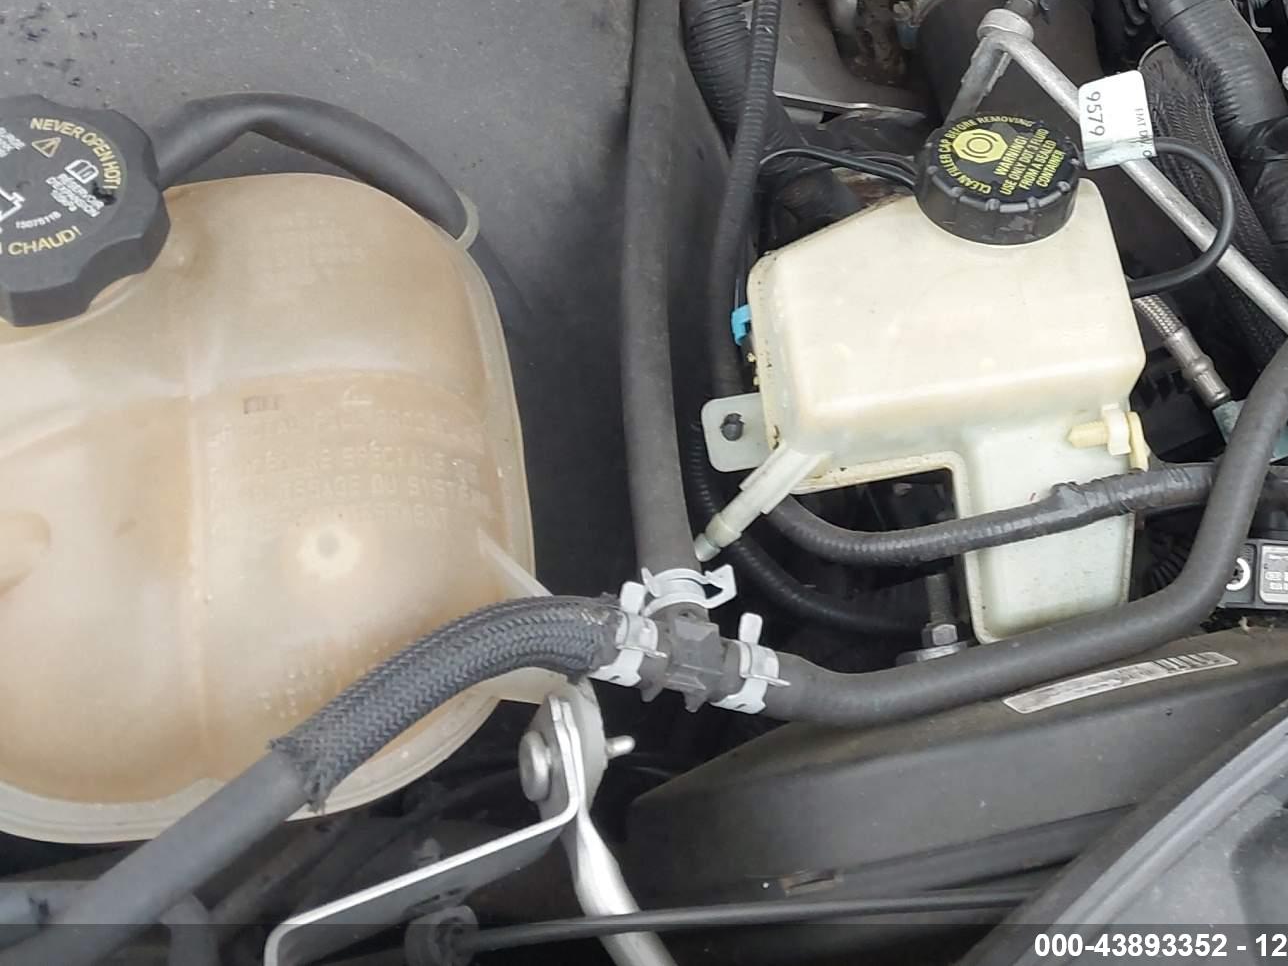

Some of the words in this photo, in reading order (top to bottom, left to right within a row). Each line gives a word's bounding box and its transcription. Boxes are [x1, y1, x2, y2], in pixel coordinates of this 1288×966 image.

[976, 115, 1035, 128] REMOVING
[1086, 91, 1105, 136] 9579
[943, 119, 978, 139] BEFORE
[1031, 128, 1049, 145] FLUID
[30, 117, 85, 139] NEVER
[81, 132, 115, 164] OPEN
[938, 138, 953, 153] CAP
[938, 153, 961, 177] FILLER
[993, 135, 1029, 176] WARNING!
[1018, 168, 1040, 190] FROM
[1035, 139, 1057, 163] SEALED
[1020, 149, 1035, 165] DOT
[1007, 162, 1028, 181] ONLY
[1035, 149, 1067, 188] CONTAINER
[956, 174, 992, 195] CLEAN
[1000, 179, 1018, 195] USE
[8, 225, 82, 255] CHAUD!
